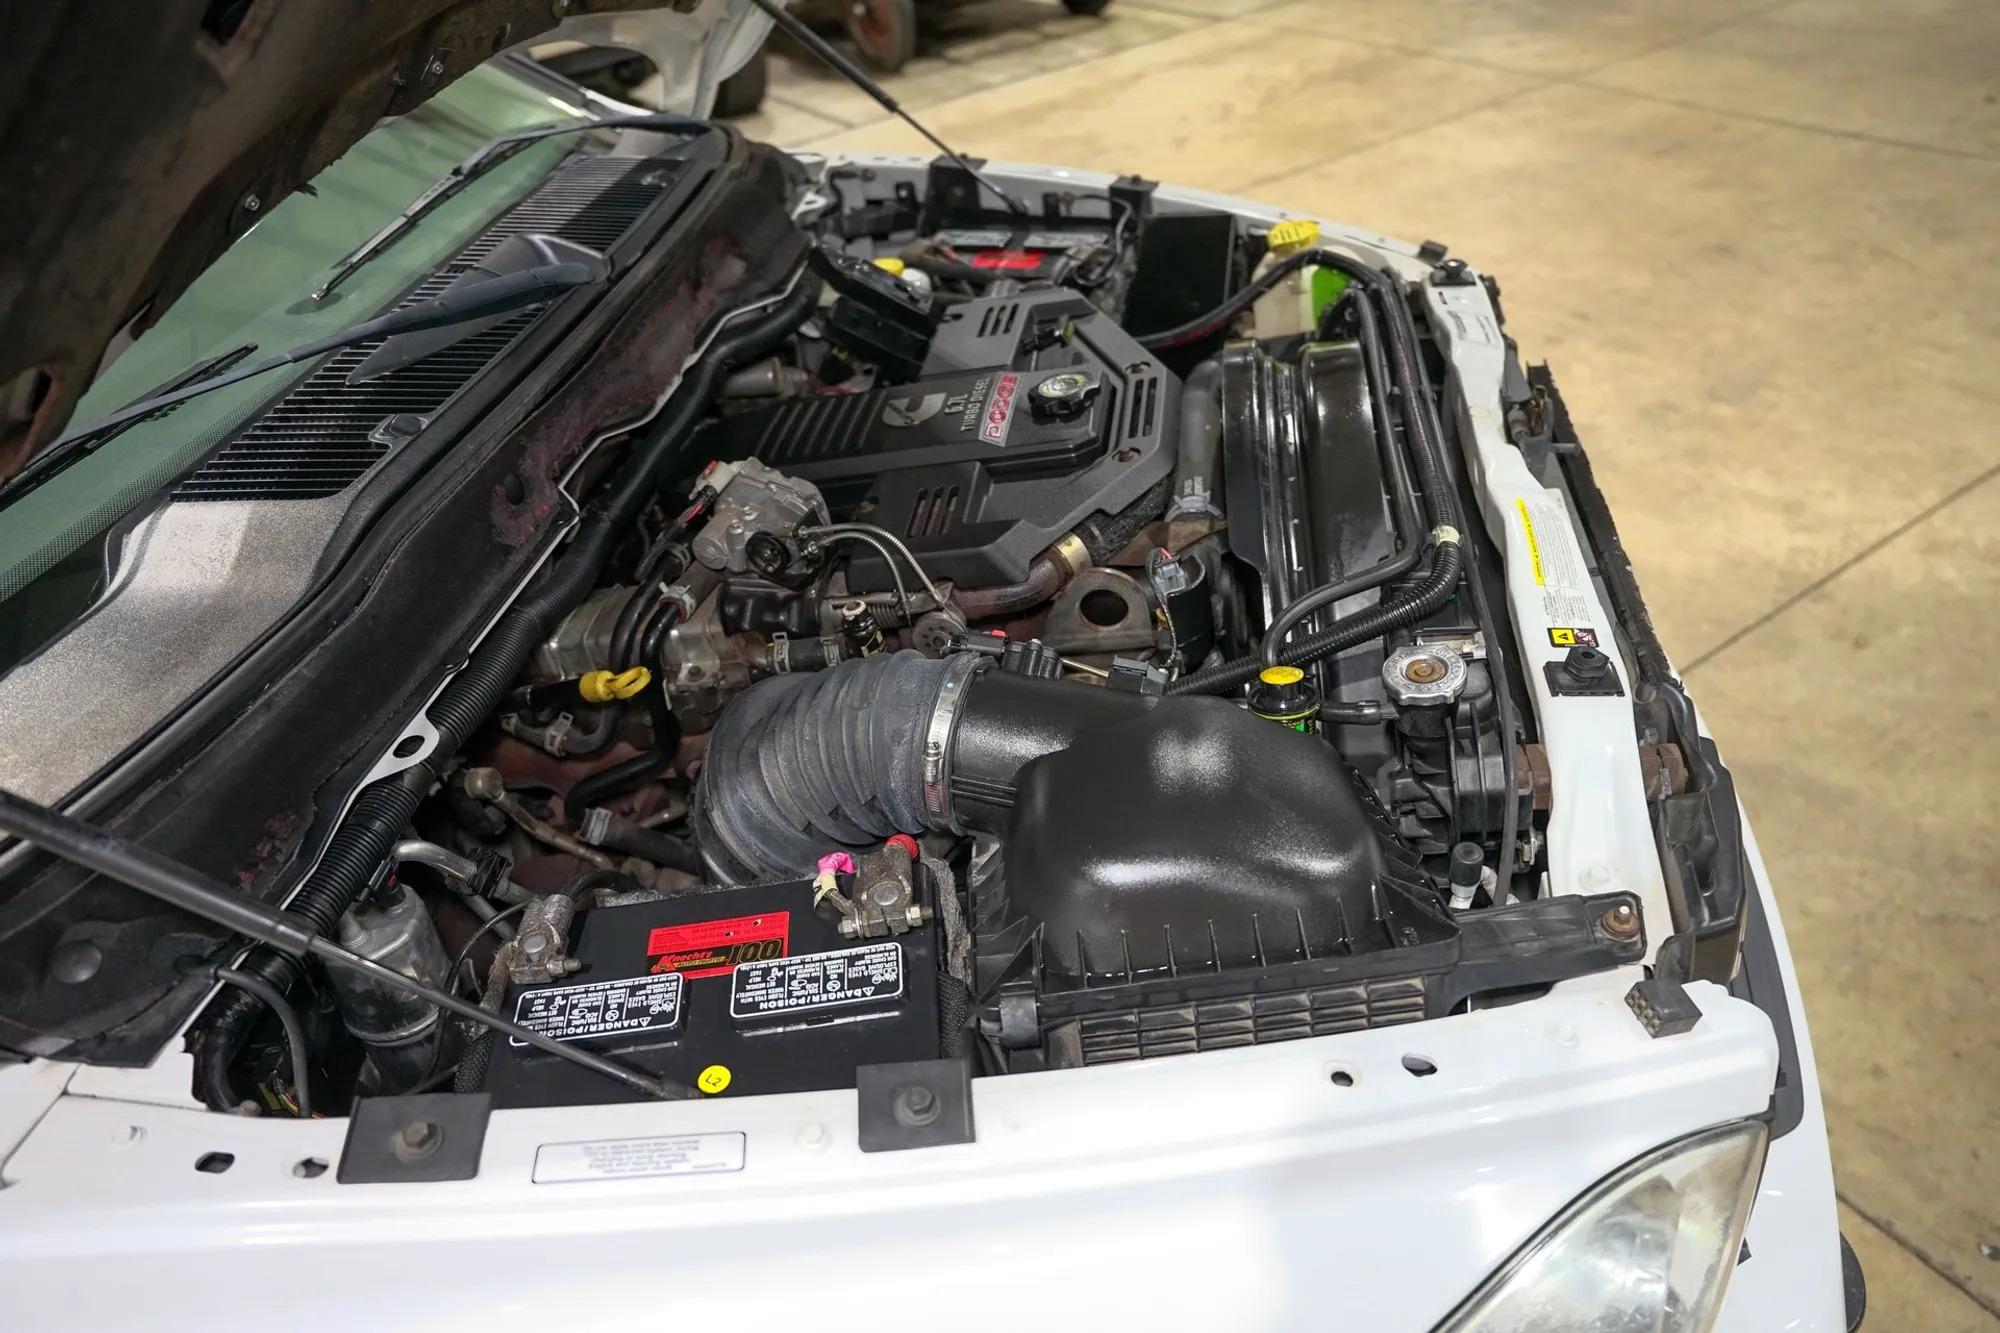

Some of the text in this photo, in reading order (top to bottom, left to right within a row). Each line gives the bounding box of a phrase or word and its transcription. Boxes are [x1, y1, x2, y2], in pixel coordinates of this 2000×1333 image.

[944, 393, 968, 415] 6.7L
[961, 377, 990, 432] TURBO DIESEL
[985, 373, 1018, 438] DODGE
[726, 939, 782, 965] 100
[759, 988, 861, 1009] DANGER/POISON
